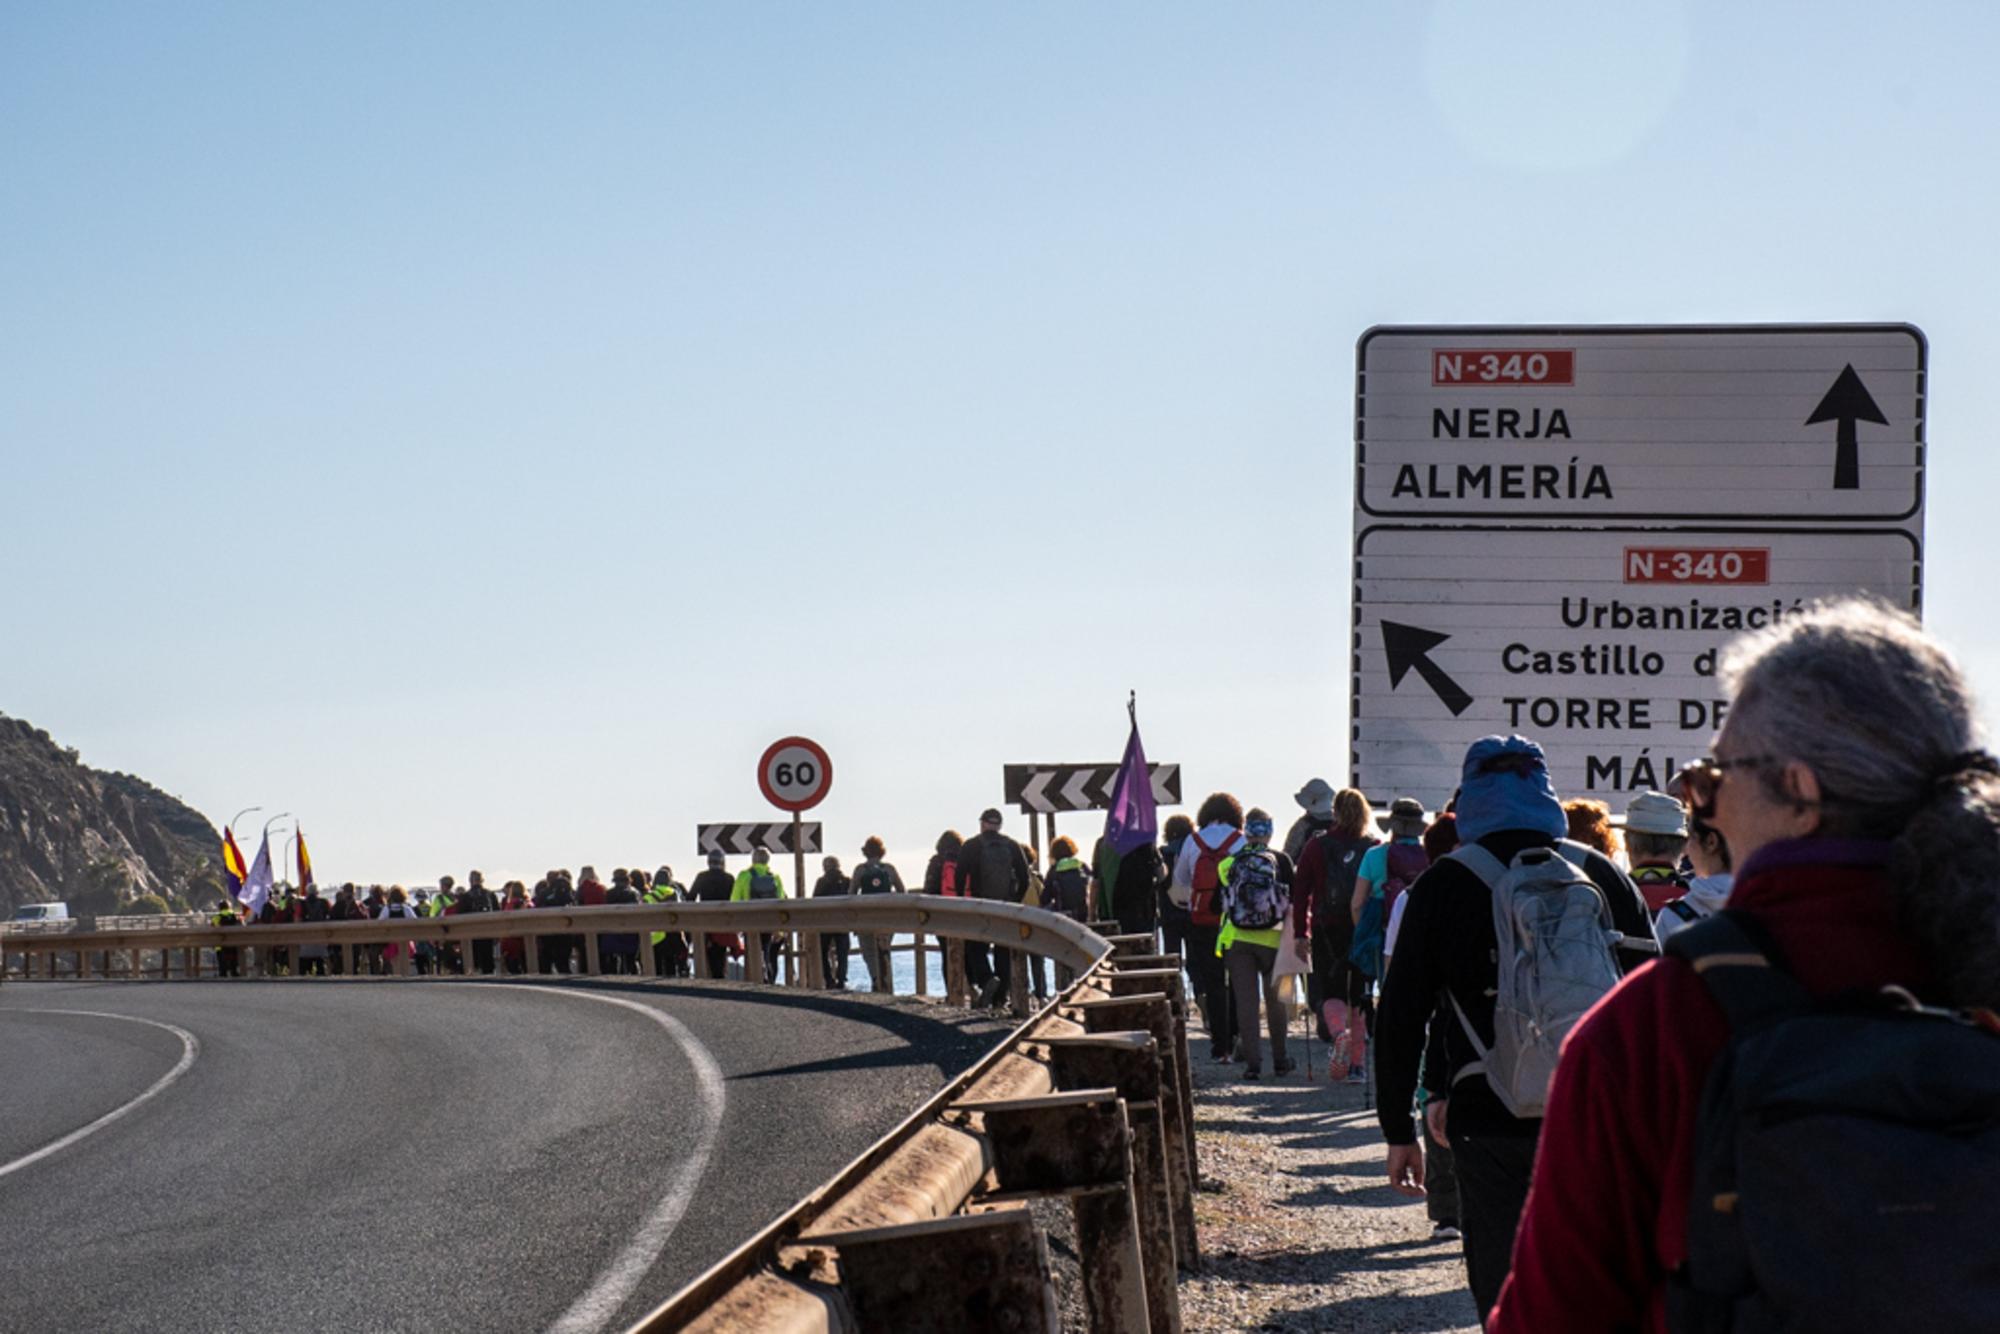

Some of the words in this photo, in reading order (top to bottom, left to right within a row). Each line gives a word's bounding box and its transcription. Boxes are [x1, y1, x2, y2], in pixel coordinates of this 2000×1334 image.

[1437, 353, 1549, 381] N-340
[1432, 408, 1572, 439] NERJA
[1391, 456, 1613, 499] ALMERÍA
[1629, 551, 1743, 580] N-340
[1502, 643, 1665, 675] Castillo
[1502, 697, 1652, 730] TORRE
[775, 761, 816, 787] 60
